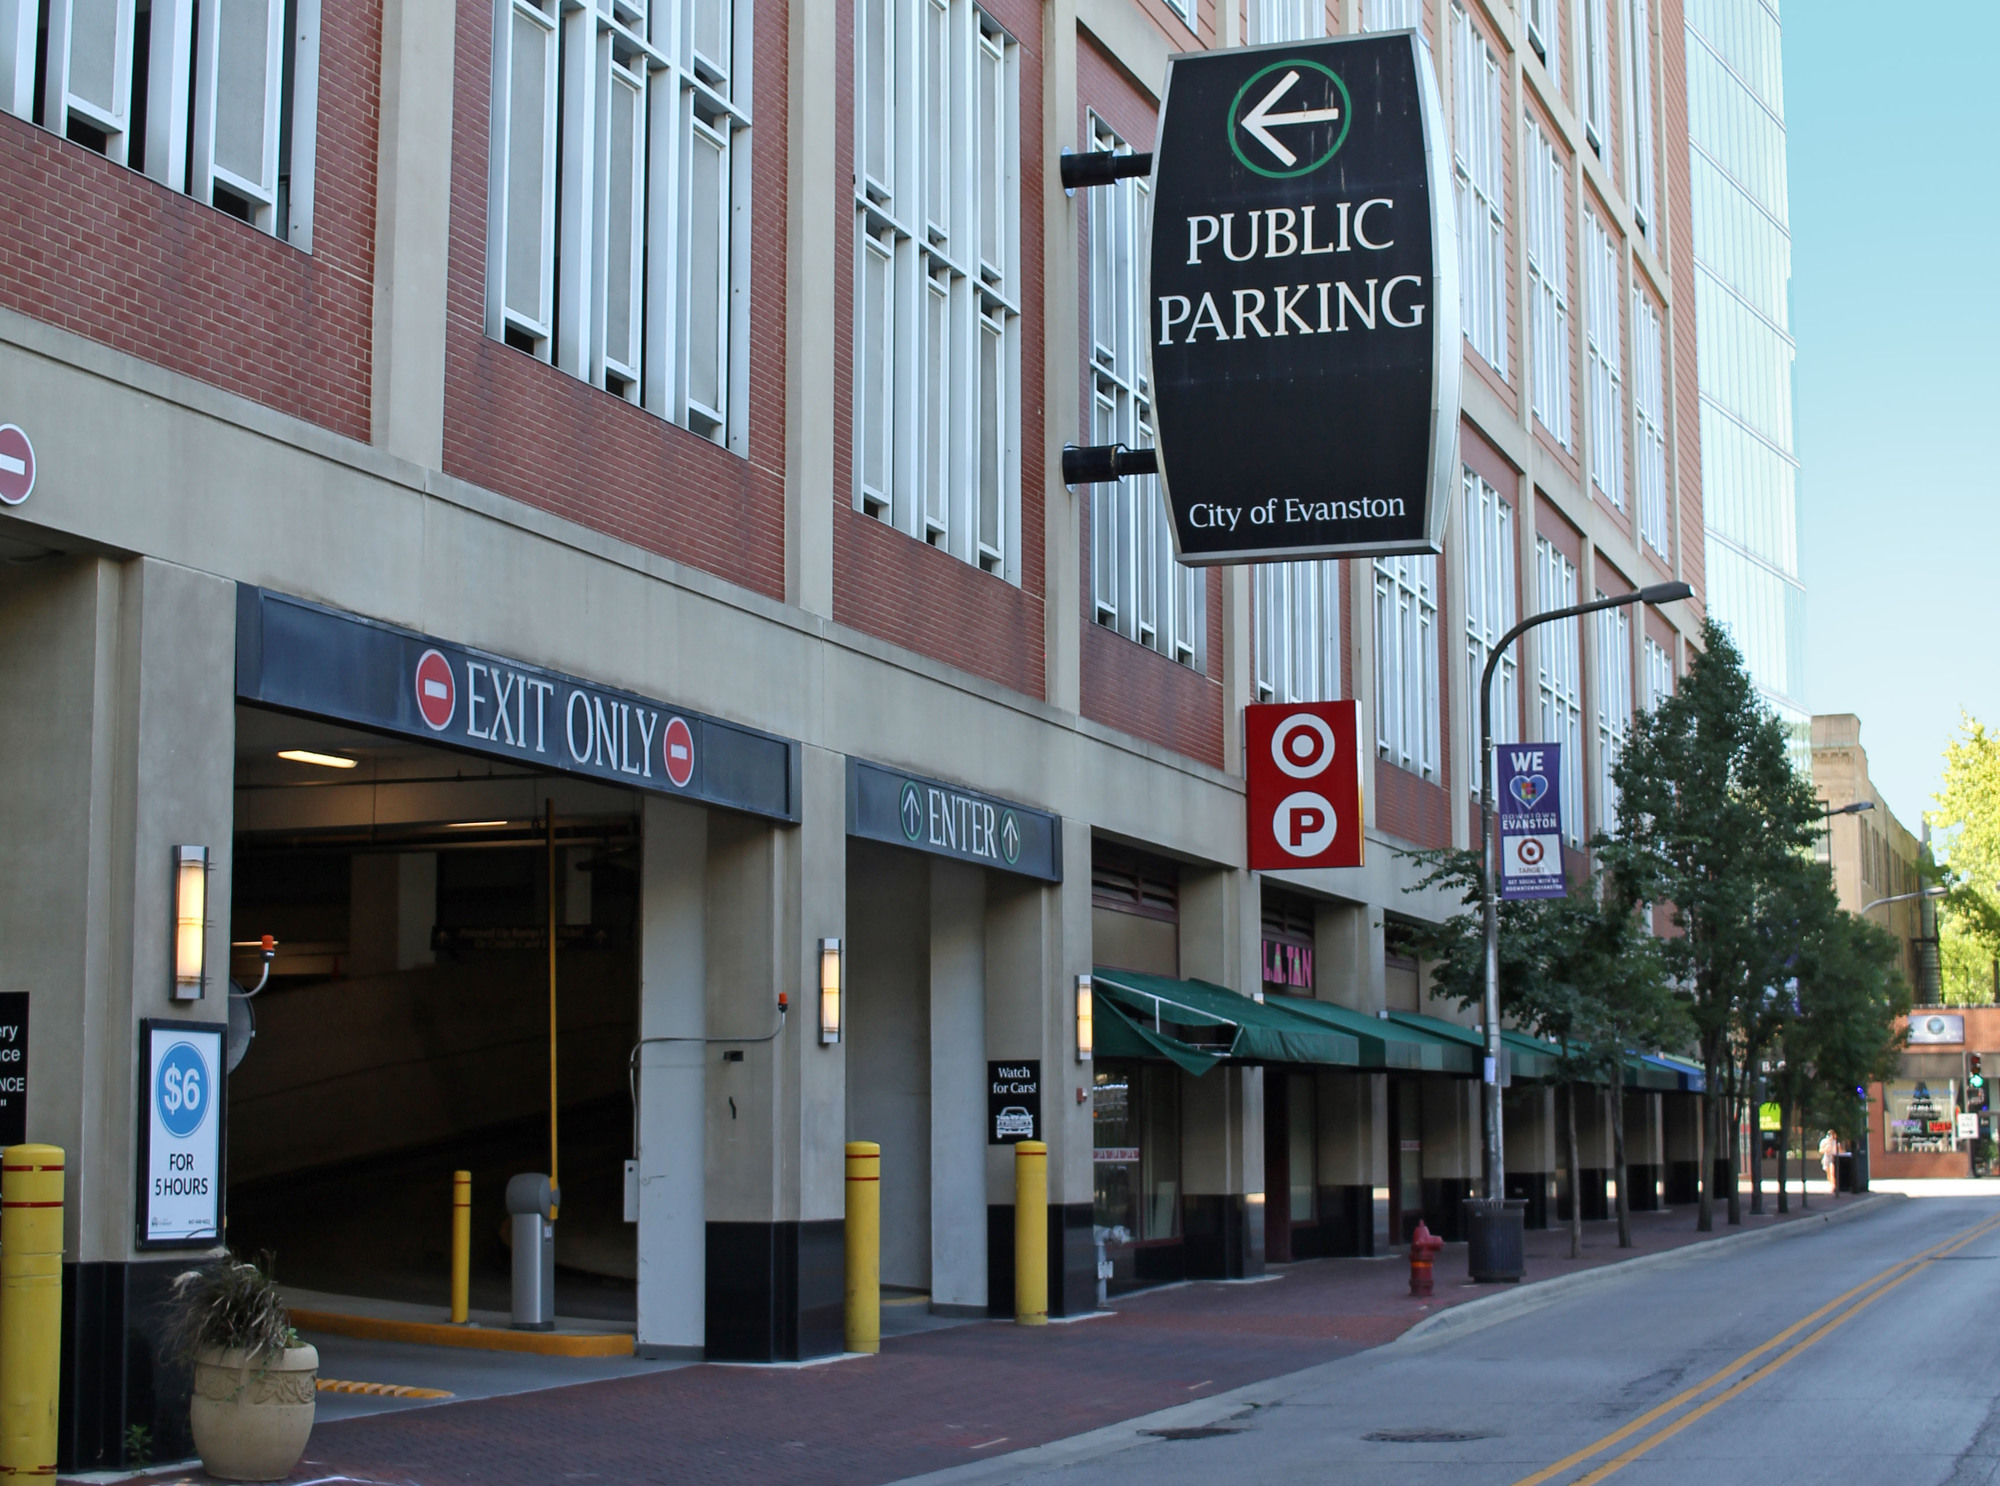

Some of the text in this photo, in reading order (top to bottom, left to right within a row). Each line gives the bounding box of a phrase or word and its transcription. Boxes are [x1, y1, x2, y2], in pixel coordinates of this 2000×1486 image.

[1187, 198, 1395, 265] PUBLIC
[1158, 274, 1425, 346] PARKING
[1189, 496, 1406, 532] City of Evanston
[466, 661, 658, 778] EXIT ONLY
[1511, 752, 1543, 772] WE
[928, 789, 998, 859] ENTER
[1289, 808, 1325, 846] P
[1502, 818, 1557, 830] EVANSTON
[0, 1025, 18, 1042] ry
[998, 1066, 1030, 1078] Watch
[164, 1063, 200, 1114] $6
[993, 1082, 1036, 1094] for Cars!
[169, 1153, 194, 1171] FOR
[155, 1178, 208, 1196] 5 HOURS
